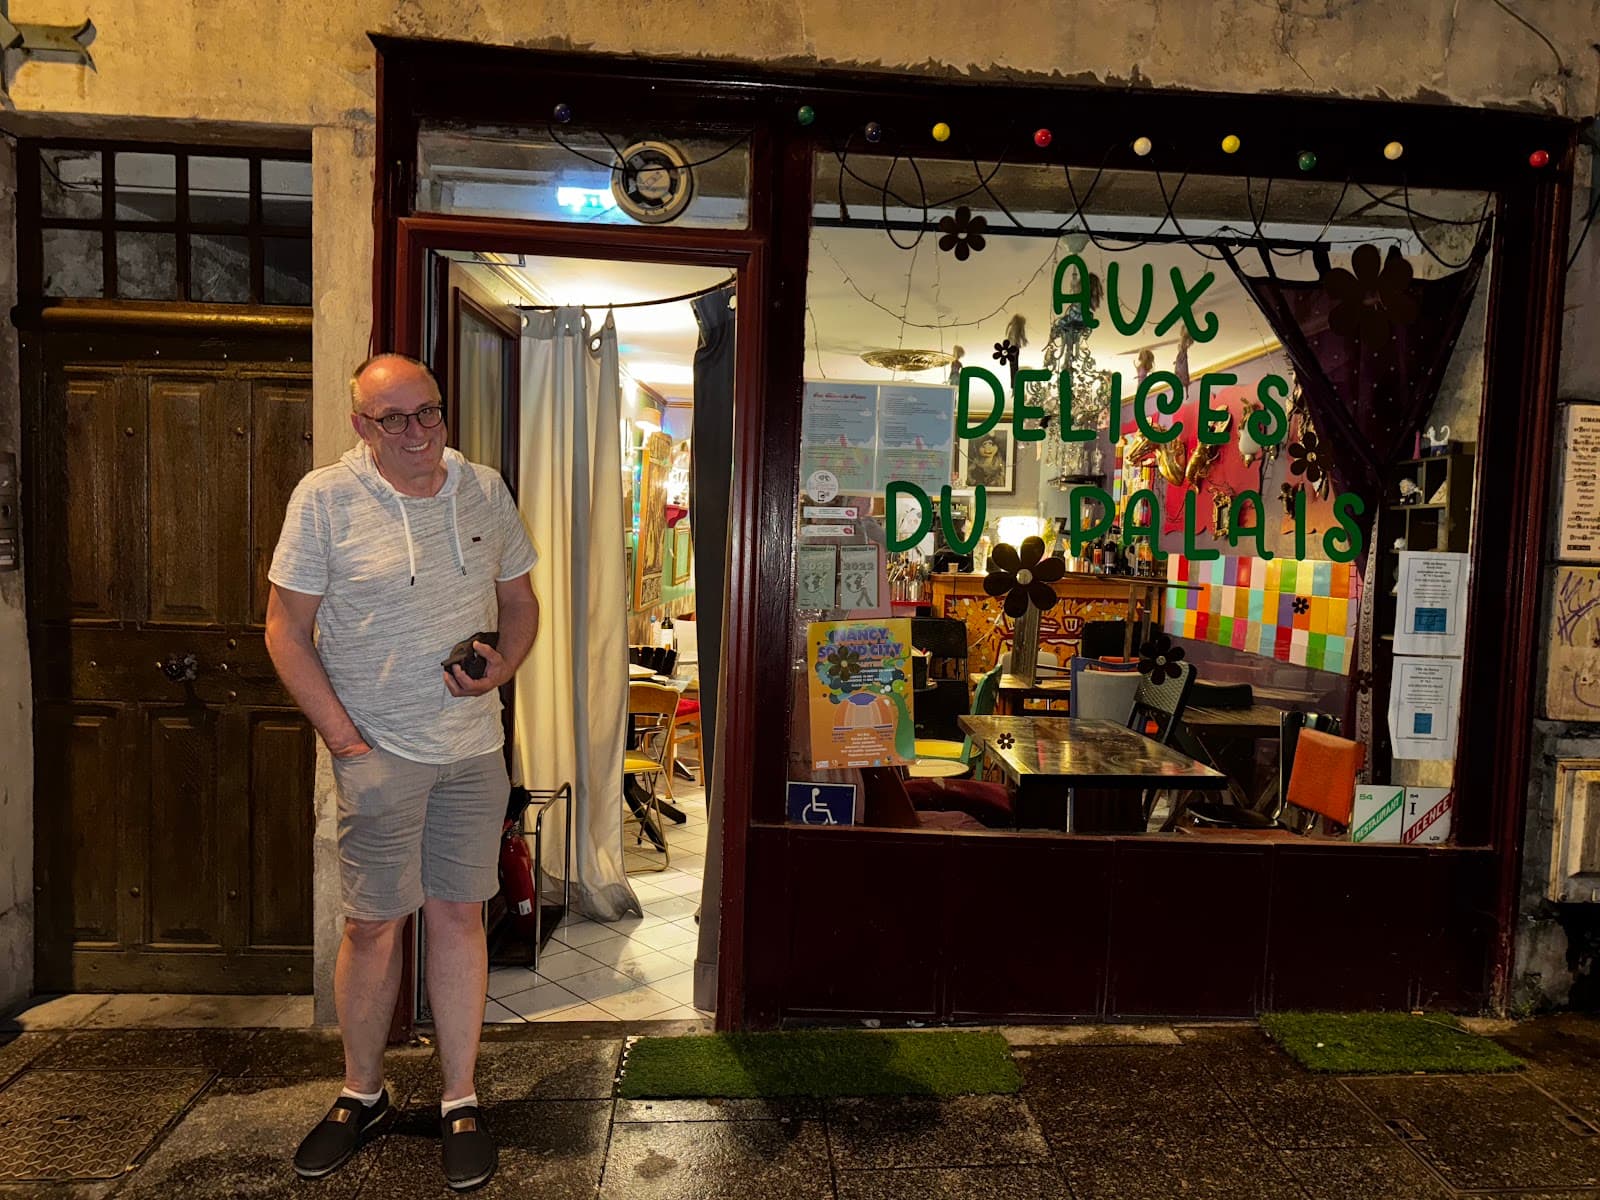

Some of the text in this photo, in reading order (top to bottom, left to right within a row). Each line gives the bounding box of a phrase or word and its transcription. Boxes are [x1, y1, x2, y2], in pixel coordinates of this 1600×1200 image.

[1053, 255, 1219, 343] AUX
[957, 366, 1289, 447] DELICES
[886, 482, 1365, 563] DU PALAIS
[832, 627, 889, 642] NANCY
[870, 643, 903, 657] CITY
[1354, 796, 1402, 842] RESTAURANT
[1359, 793, 1373, 801] 54
[1405, 796, 1450, 843] LICENCE
